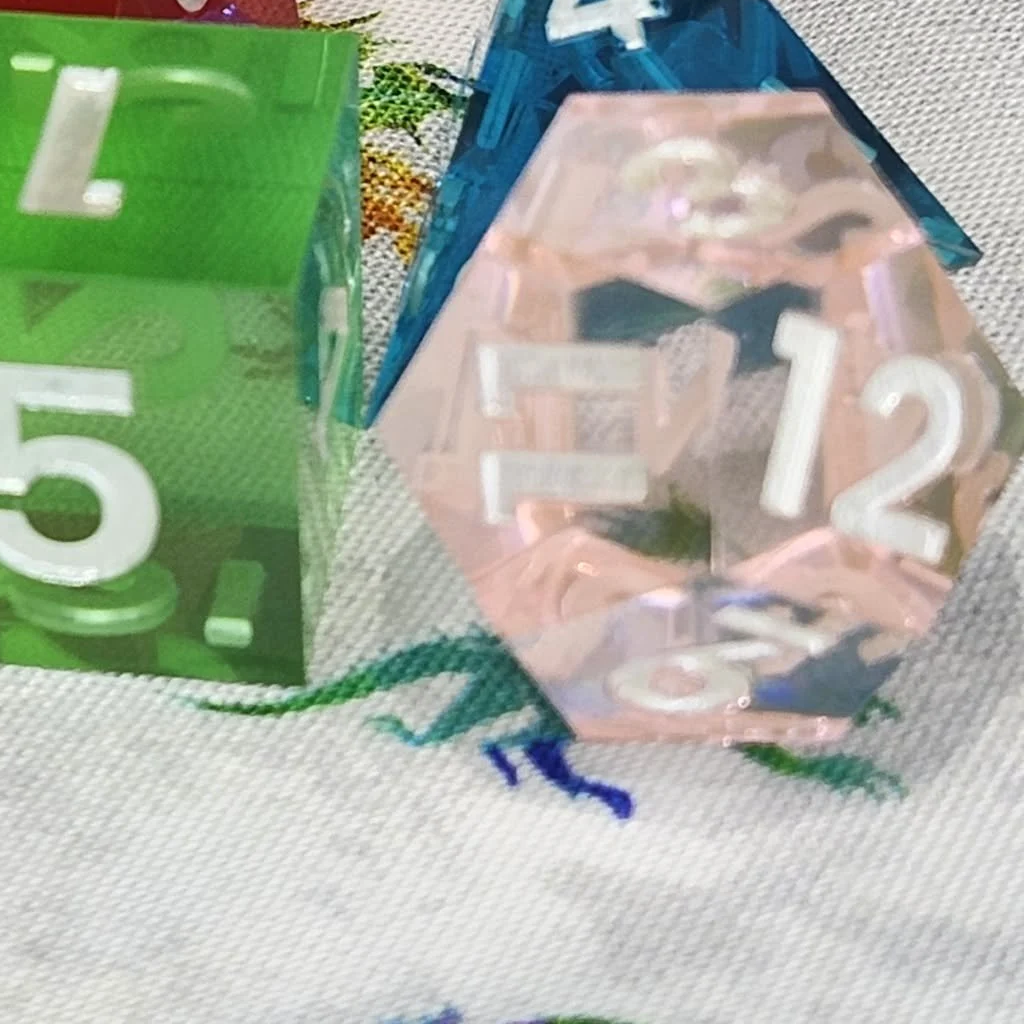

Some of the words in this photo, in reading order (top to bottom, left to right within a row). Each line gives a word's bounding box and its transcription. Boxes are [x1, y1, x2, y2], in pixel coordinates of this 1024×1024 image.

[17, 65, 124, 218] 1
[477, 341, 656, 525] 11
[760, 311, 965, 564] 12
